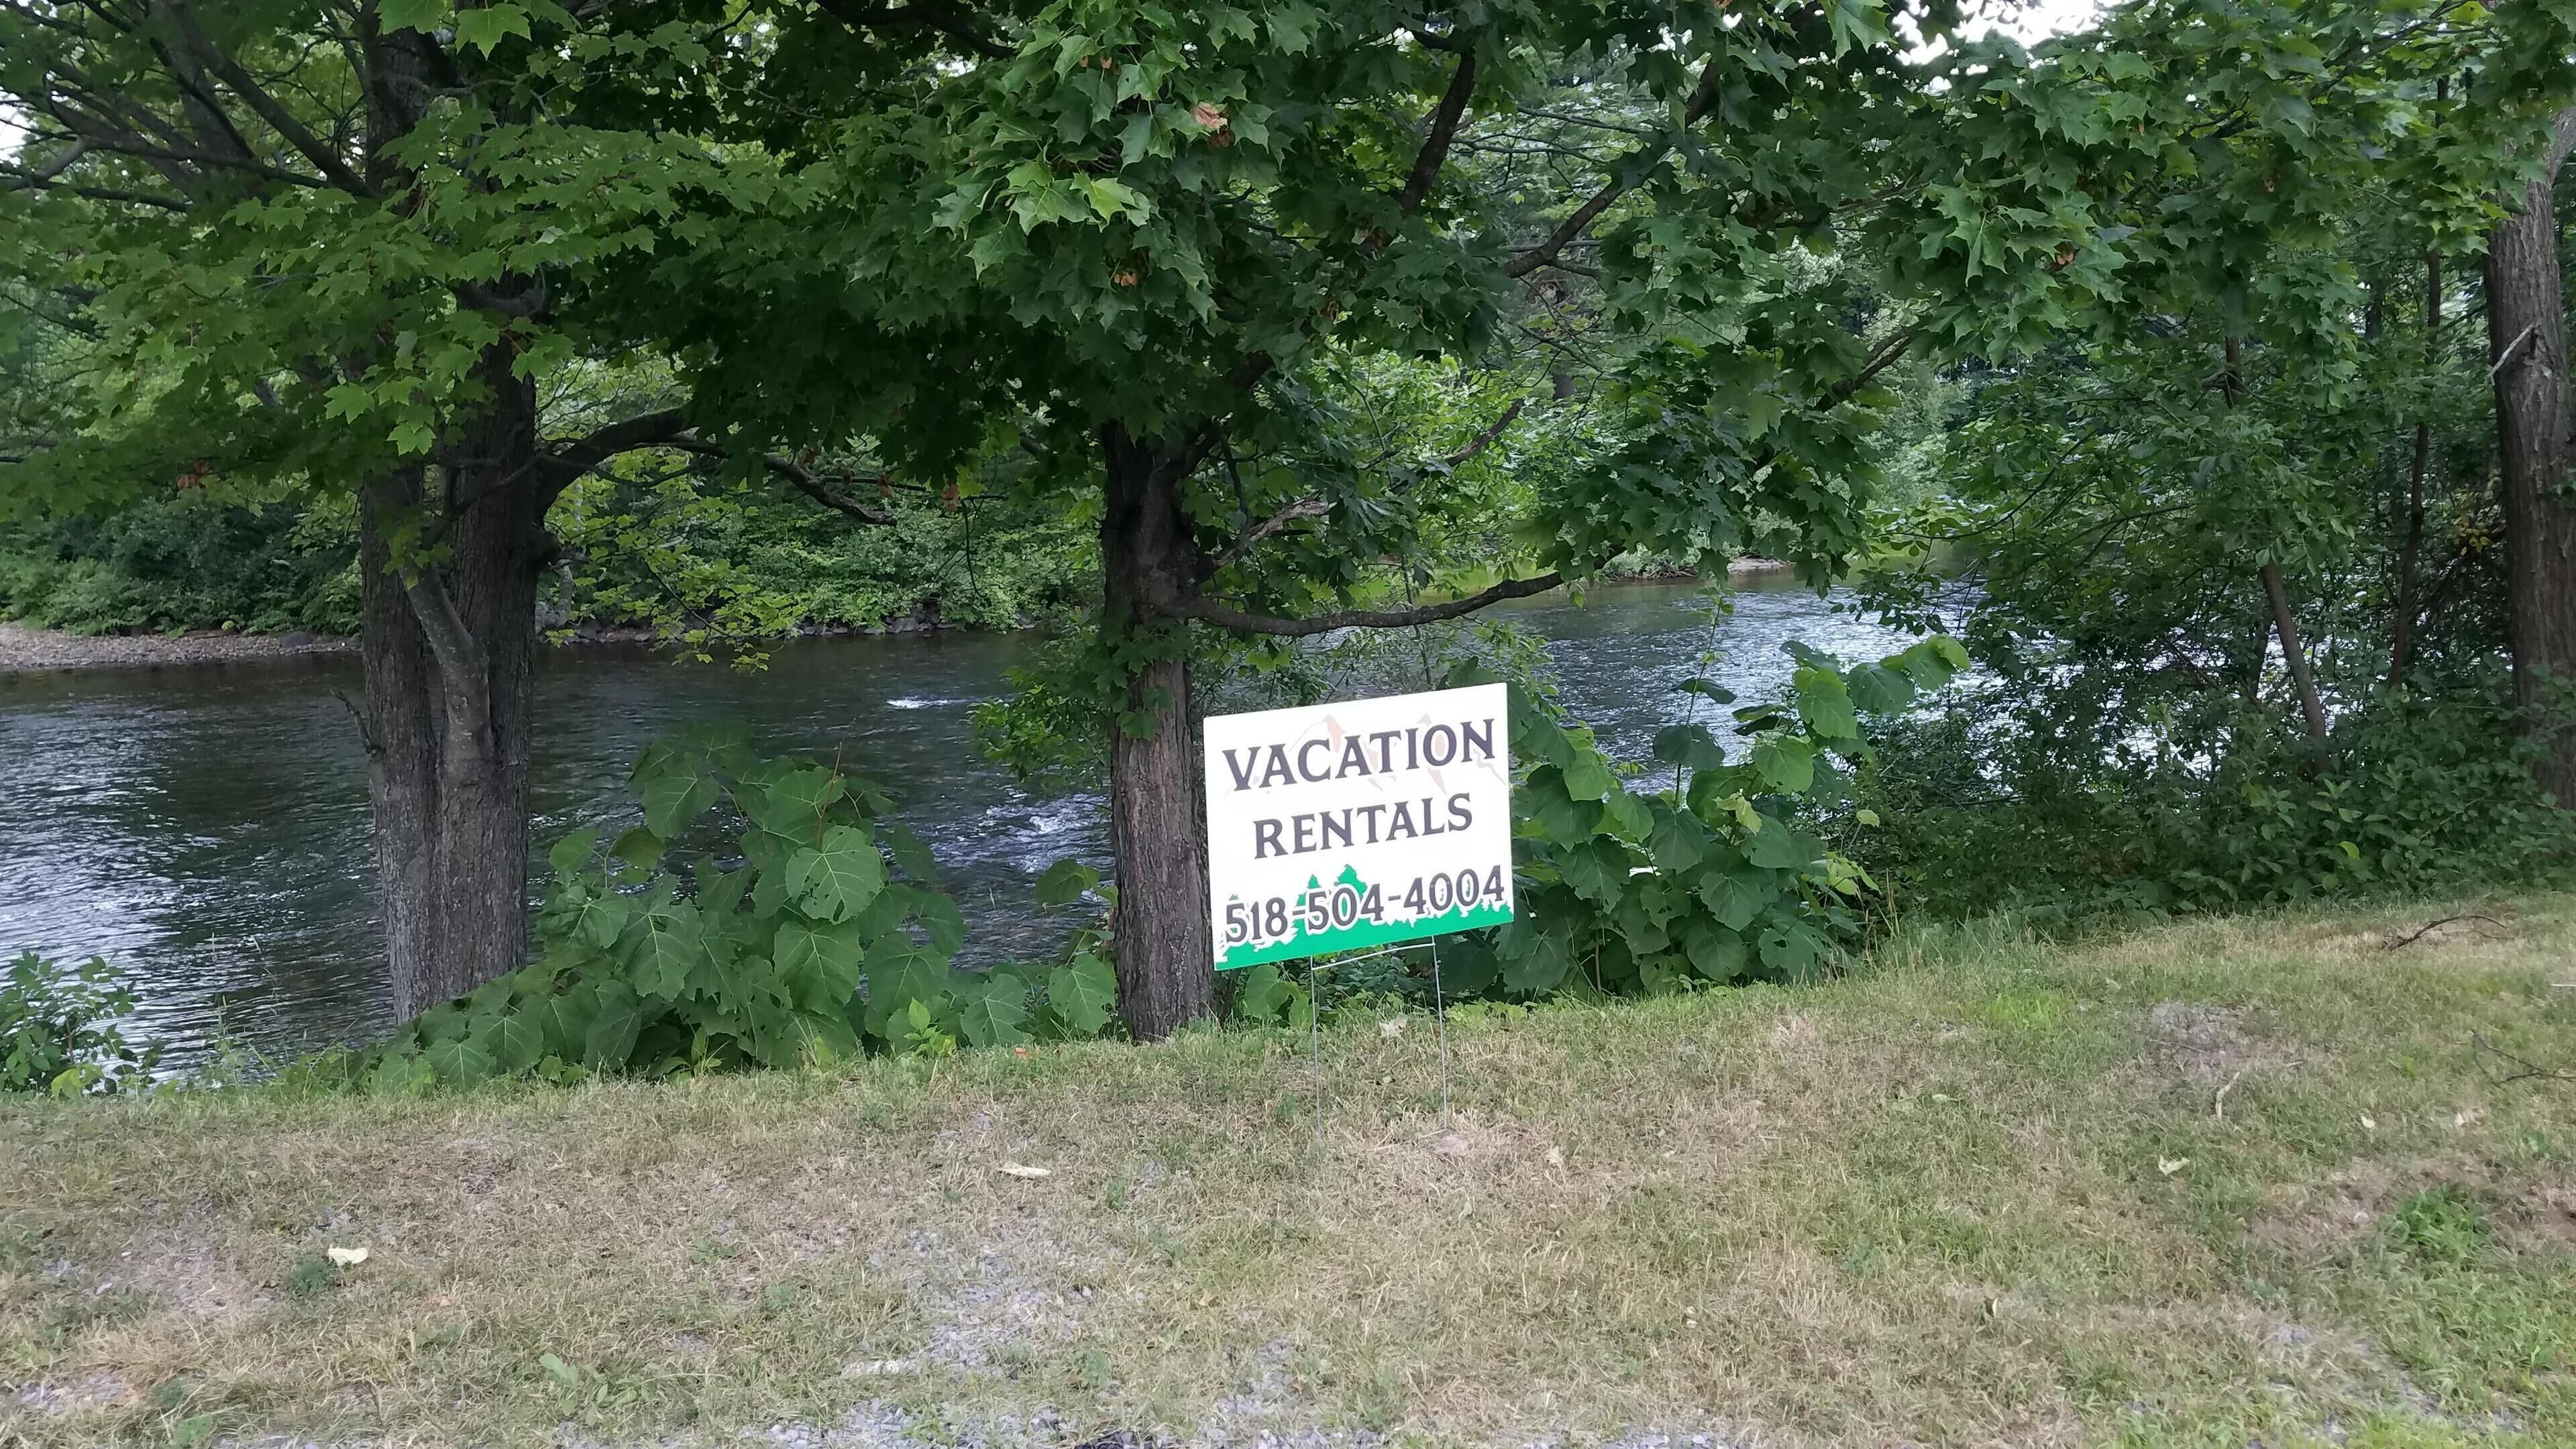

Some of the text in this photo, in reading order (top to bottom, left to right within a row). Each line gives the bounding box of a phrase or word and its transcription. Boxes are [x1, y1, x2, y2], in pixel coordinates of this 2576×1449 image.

[1222, 718, 1495, 791] VACATION
[1252, 792, 1472, 859] RENTALS
[1226, 865, 1504, 944] 518-504-4004
